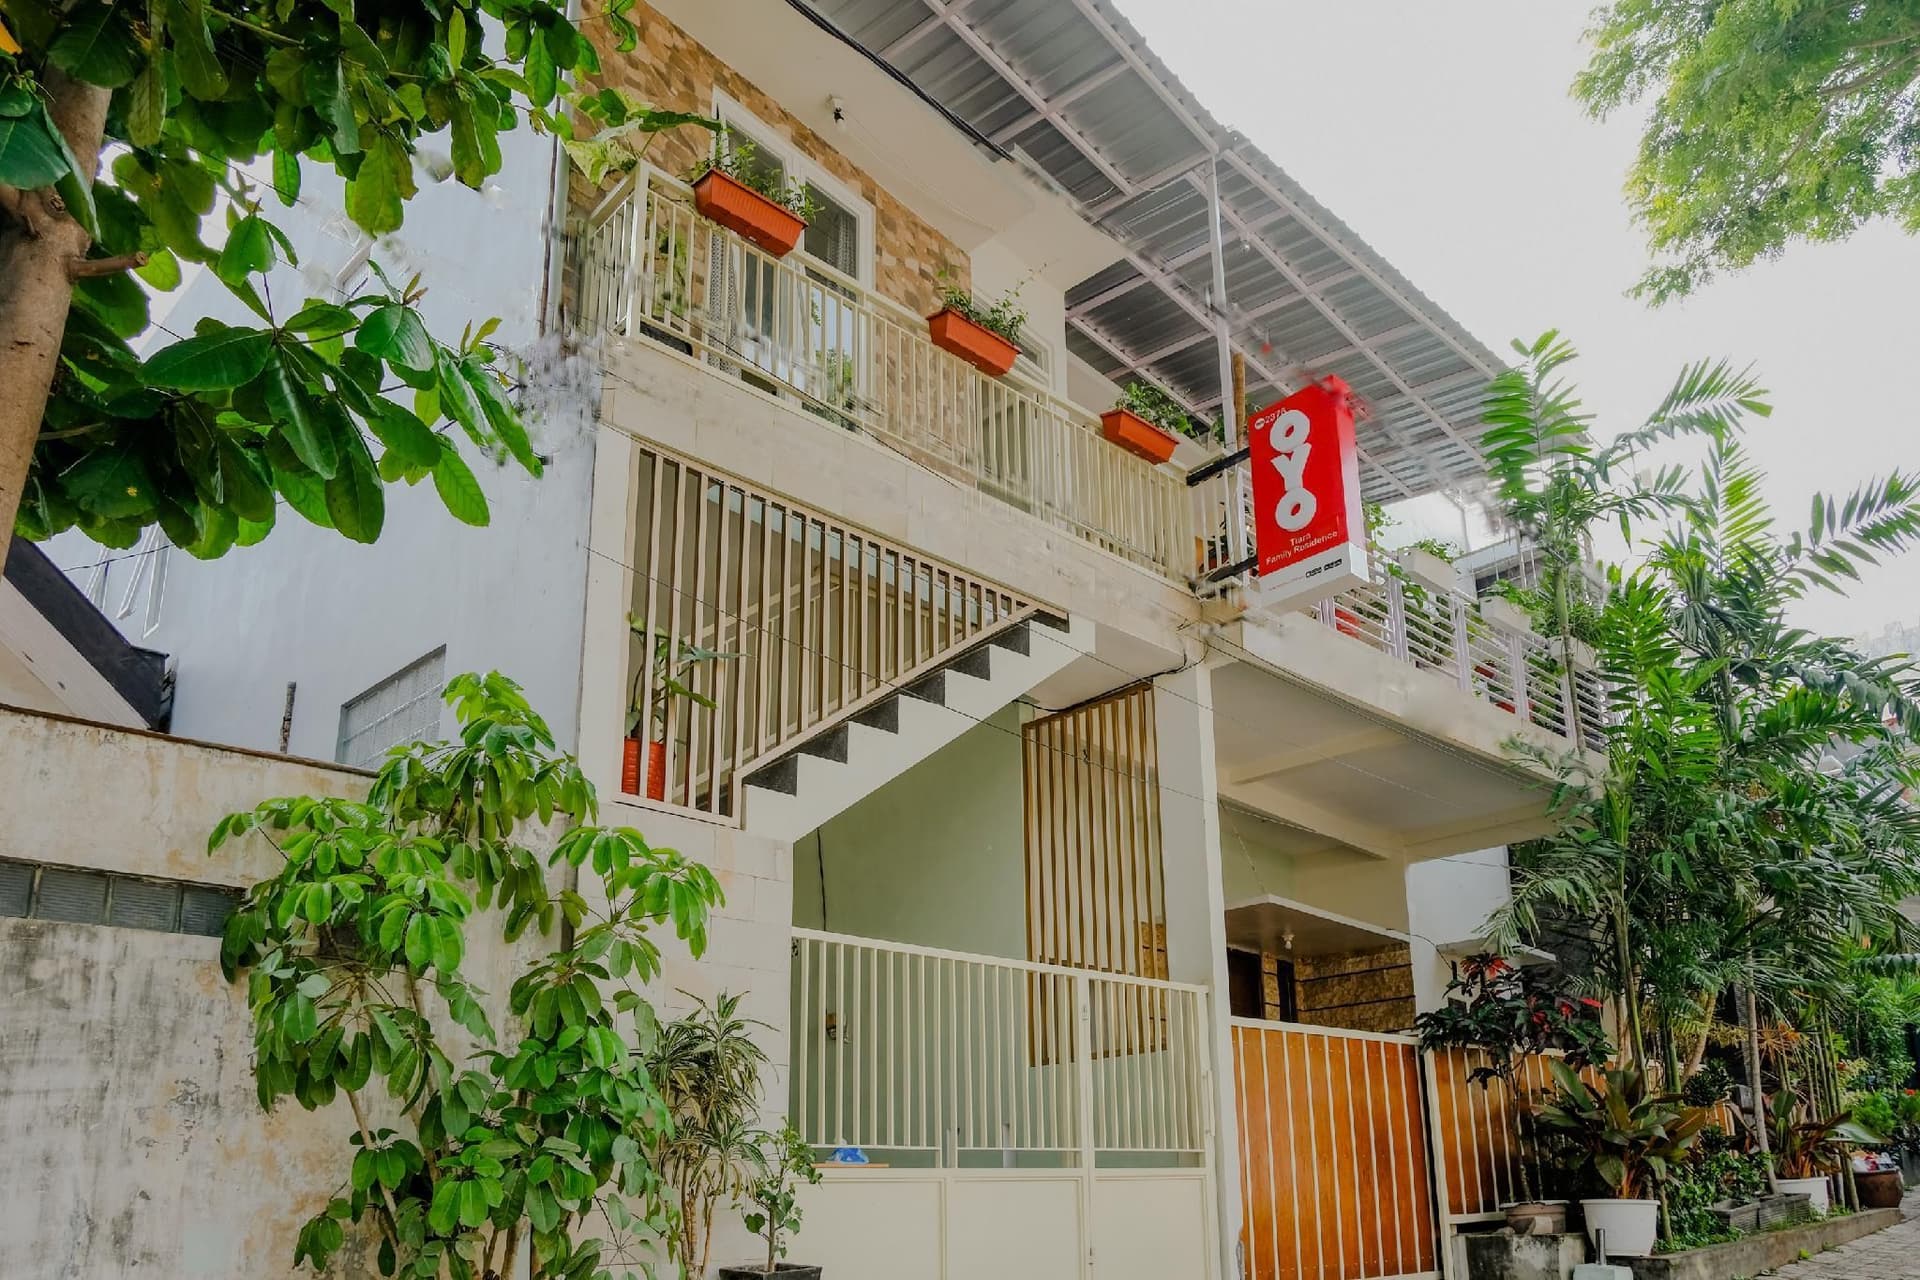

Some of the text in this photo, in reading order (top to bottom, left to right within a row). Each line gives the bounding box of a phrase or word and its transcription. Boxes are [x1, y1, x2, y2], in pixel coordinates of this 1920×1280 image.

[1269, 409, 1317, 532] OYO
[1265, 531, 1338, 566] Family Residence
[1290, 533, 1311, 546] Tiara
